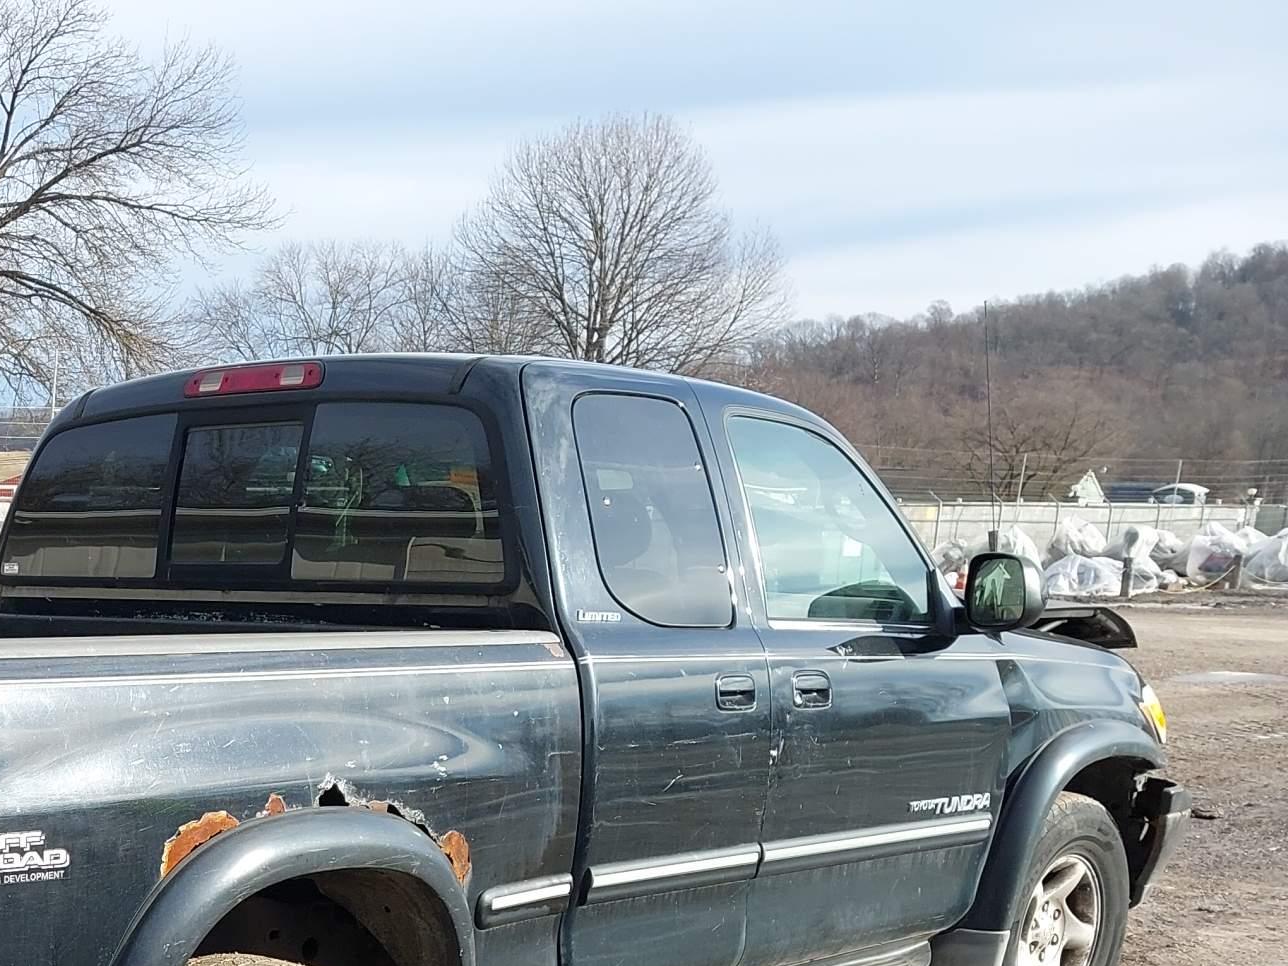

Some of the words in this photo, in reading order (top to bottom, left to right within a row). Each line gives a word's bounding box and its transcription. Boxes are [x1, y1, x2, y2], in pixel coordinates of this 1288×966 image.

[908, 800, 936, 813] TOYOTA
[934, 792, 991, 815] TUNDRA
[3, 870, 65, 884] DEVELOPMENT
